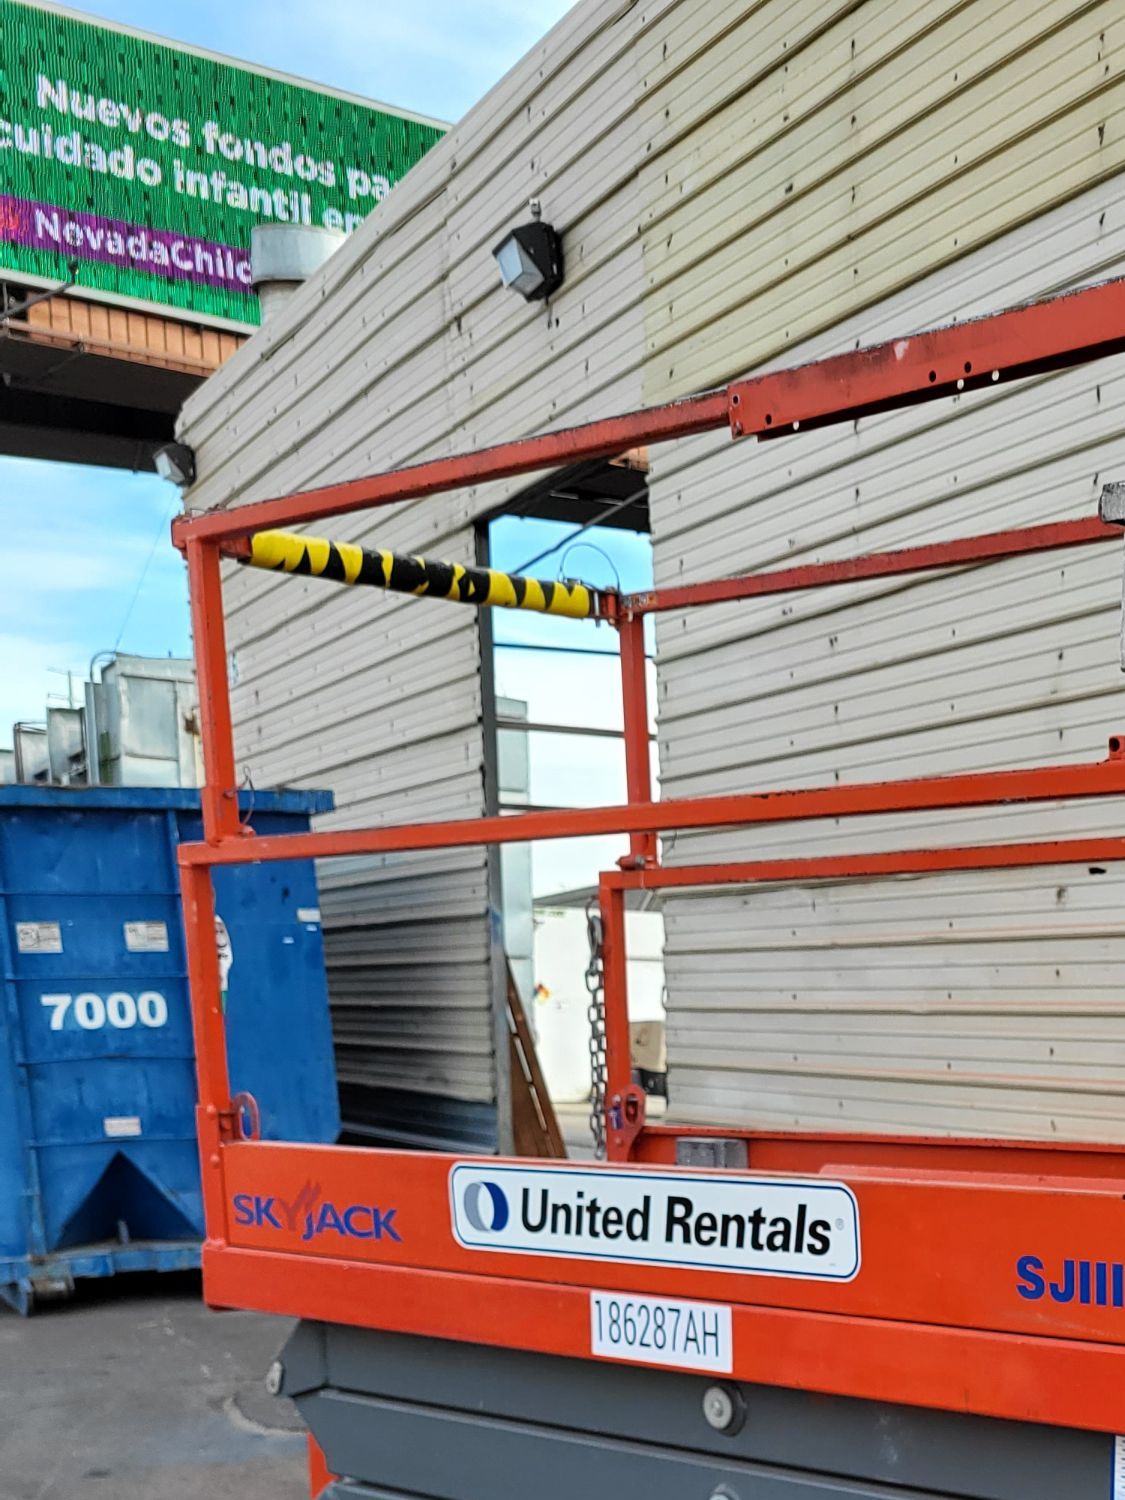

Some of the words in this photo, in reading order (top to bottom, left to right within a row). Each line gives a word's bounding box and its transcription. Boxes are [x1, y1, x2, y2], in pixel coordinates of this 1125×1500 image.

[38, 73, 191, 148] Nuevos
[203, 120, 337, 188] fondos
[346, 166, 400, 201] pa
[173, 159, 312, 227] infantil
[40, 990, 168, 1031] 7000
[233, 1181, 403, 1243] SKYJACK
[520, 1187, 650, 1242] United
[665, 1195, 832, 1256] Rentals
[1016, 1255, 1125, 1309] SJIII
[594, 1299, 719, 1358] 186287AH
